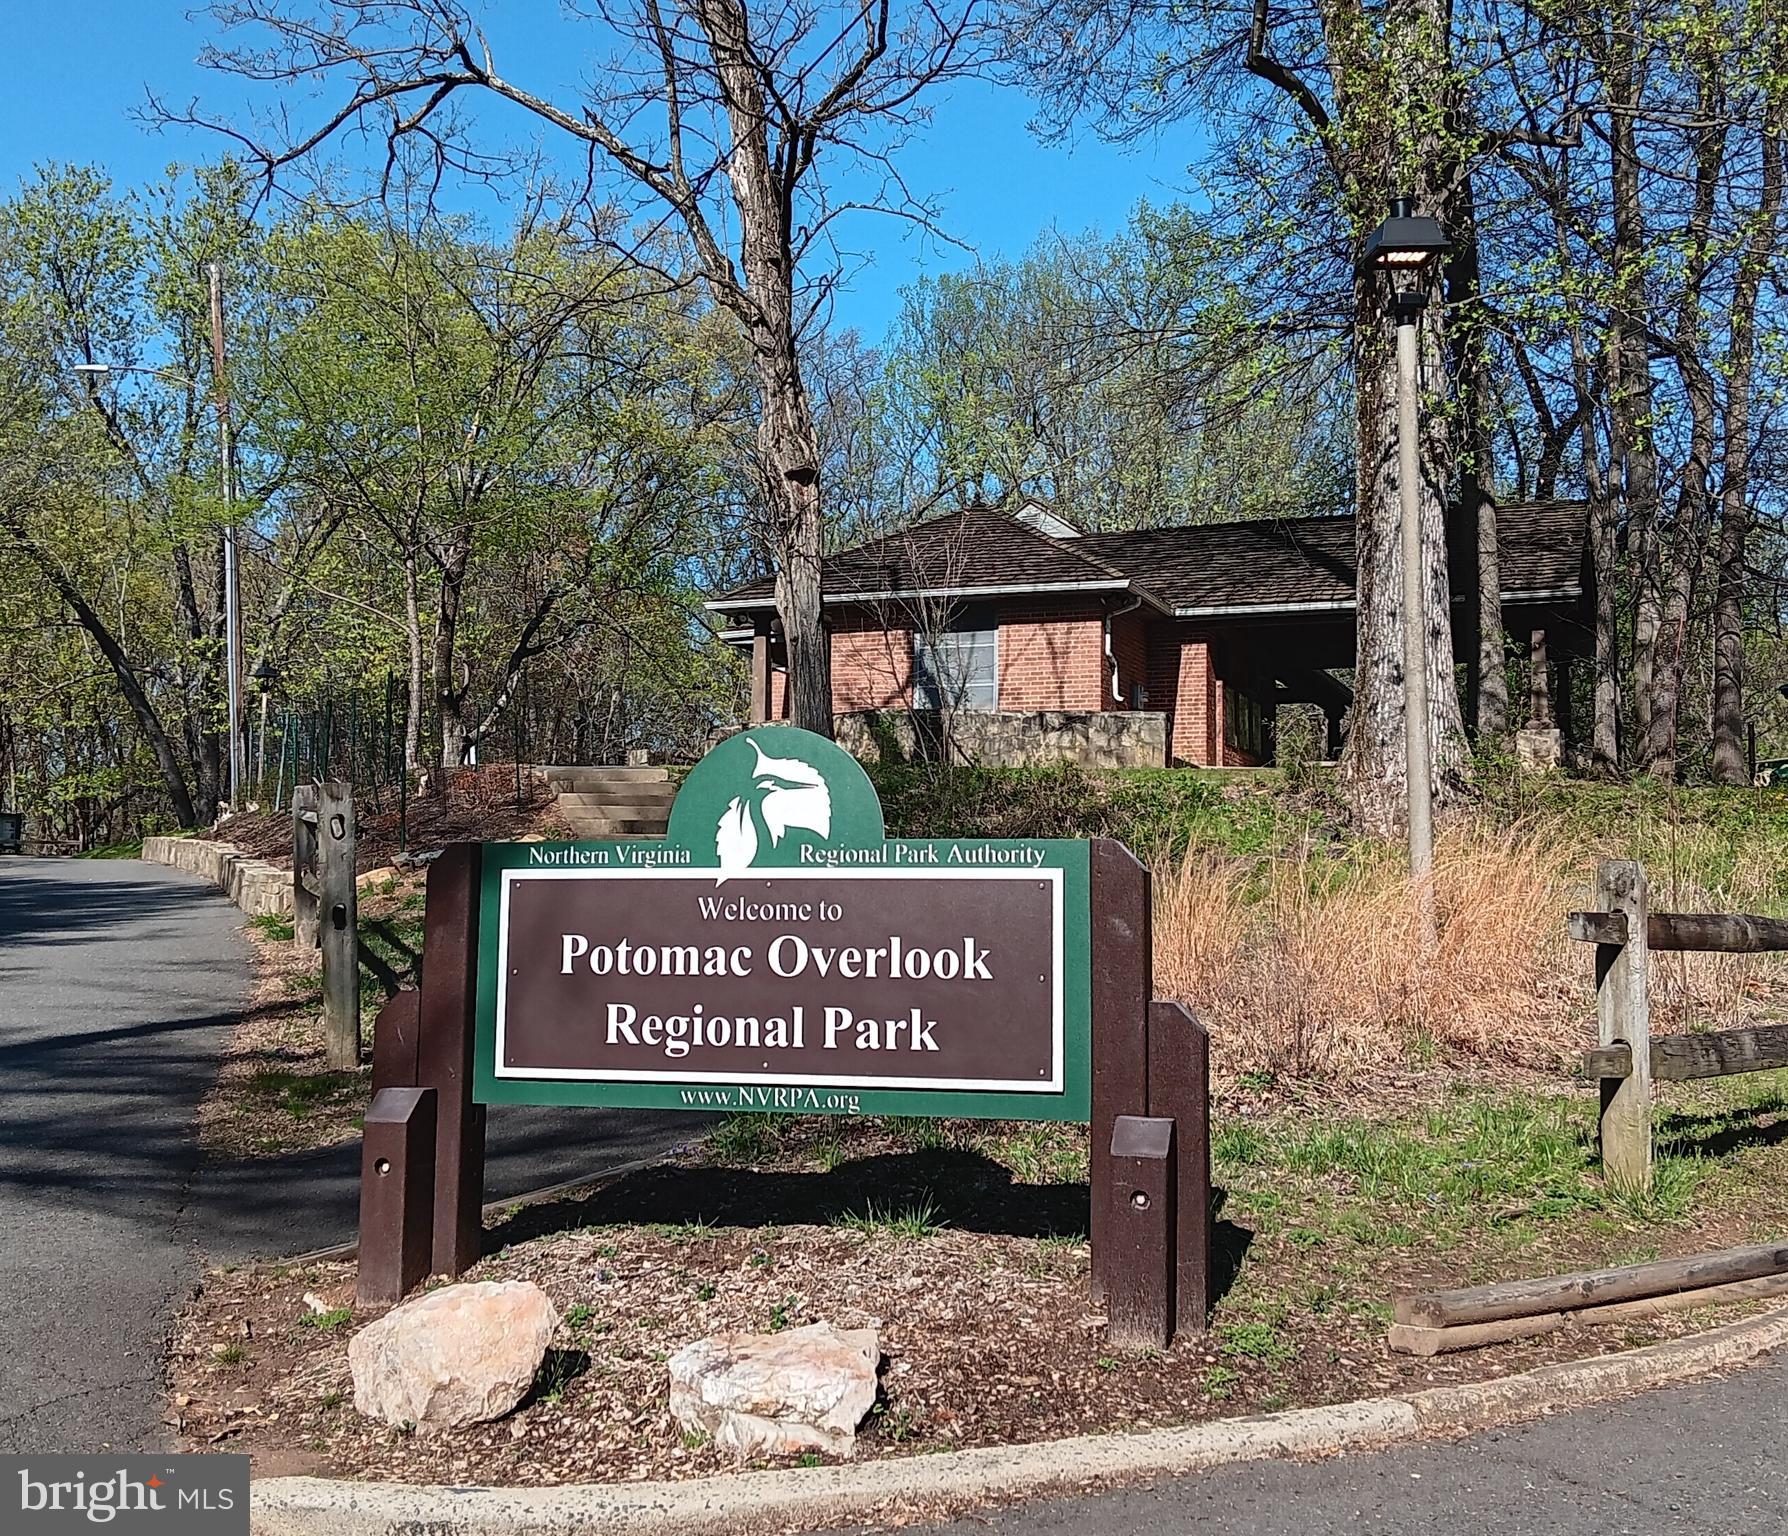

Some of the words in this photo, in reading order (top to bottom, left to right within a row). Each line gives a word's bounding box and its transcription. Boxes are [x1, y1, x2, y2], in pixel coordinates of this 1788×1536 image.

[528, 846, 610, 865] Northern
[614, 845, 692, 867] Virginia
[799, 844, 889, 868] Regional
[893, 844, 939, 865] Park
[946, 845, 1046, 868] Authority
[697, 897, 813, 921] Welcome
[817, 901, 843, 922] to
[560, 933, 753, 977] Potomac
[766, 934, 994, 981] Overlook
[604, 1003, 804, 1058] Regional
[822, 1006, 941, 1052] Park
[680, 1087, 861, 1113] www.NVRPA.org
